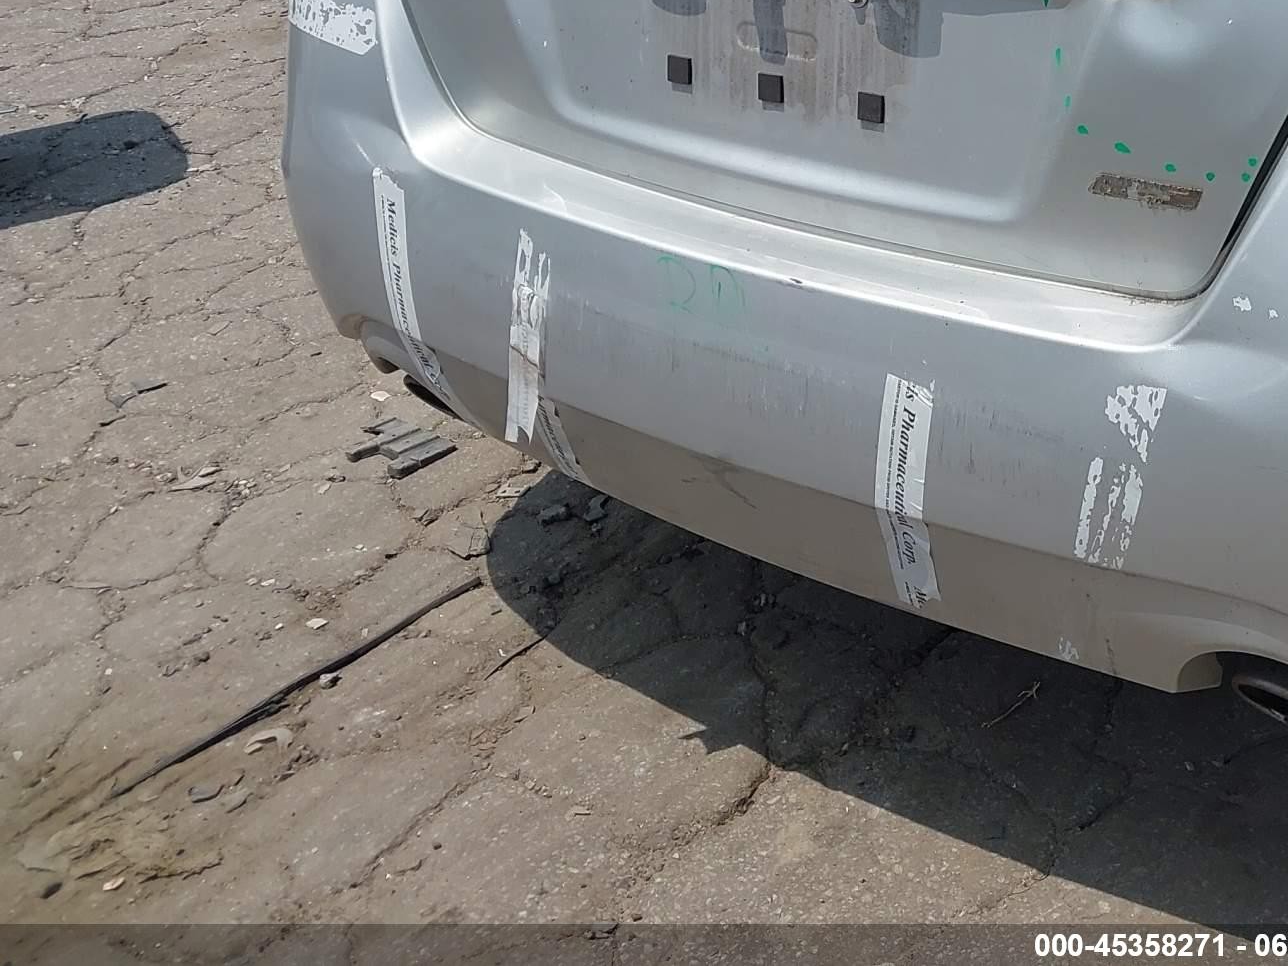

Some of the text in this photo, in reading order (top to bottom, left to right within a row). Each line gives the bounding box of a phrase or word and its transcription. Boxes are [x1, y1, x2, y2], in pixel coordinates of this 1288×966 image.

[386, 197, 398, 257] Medicis
[893, 406, 916, 531] Pharmaceutical
[901, 532, 916, 566] Corp.
